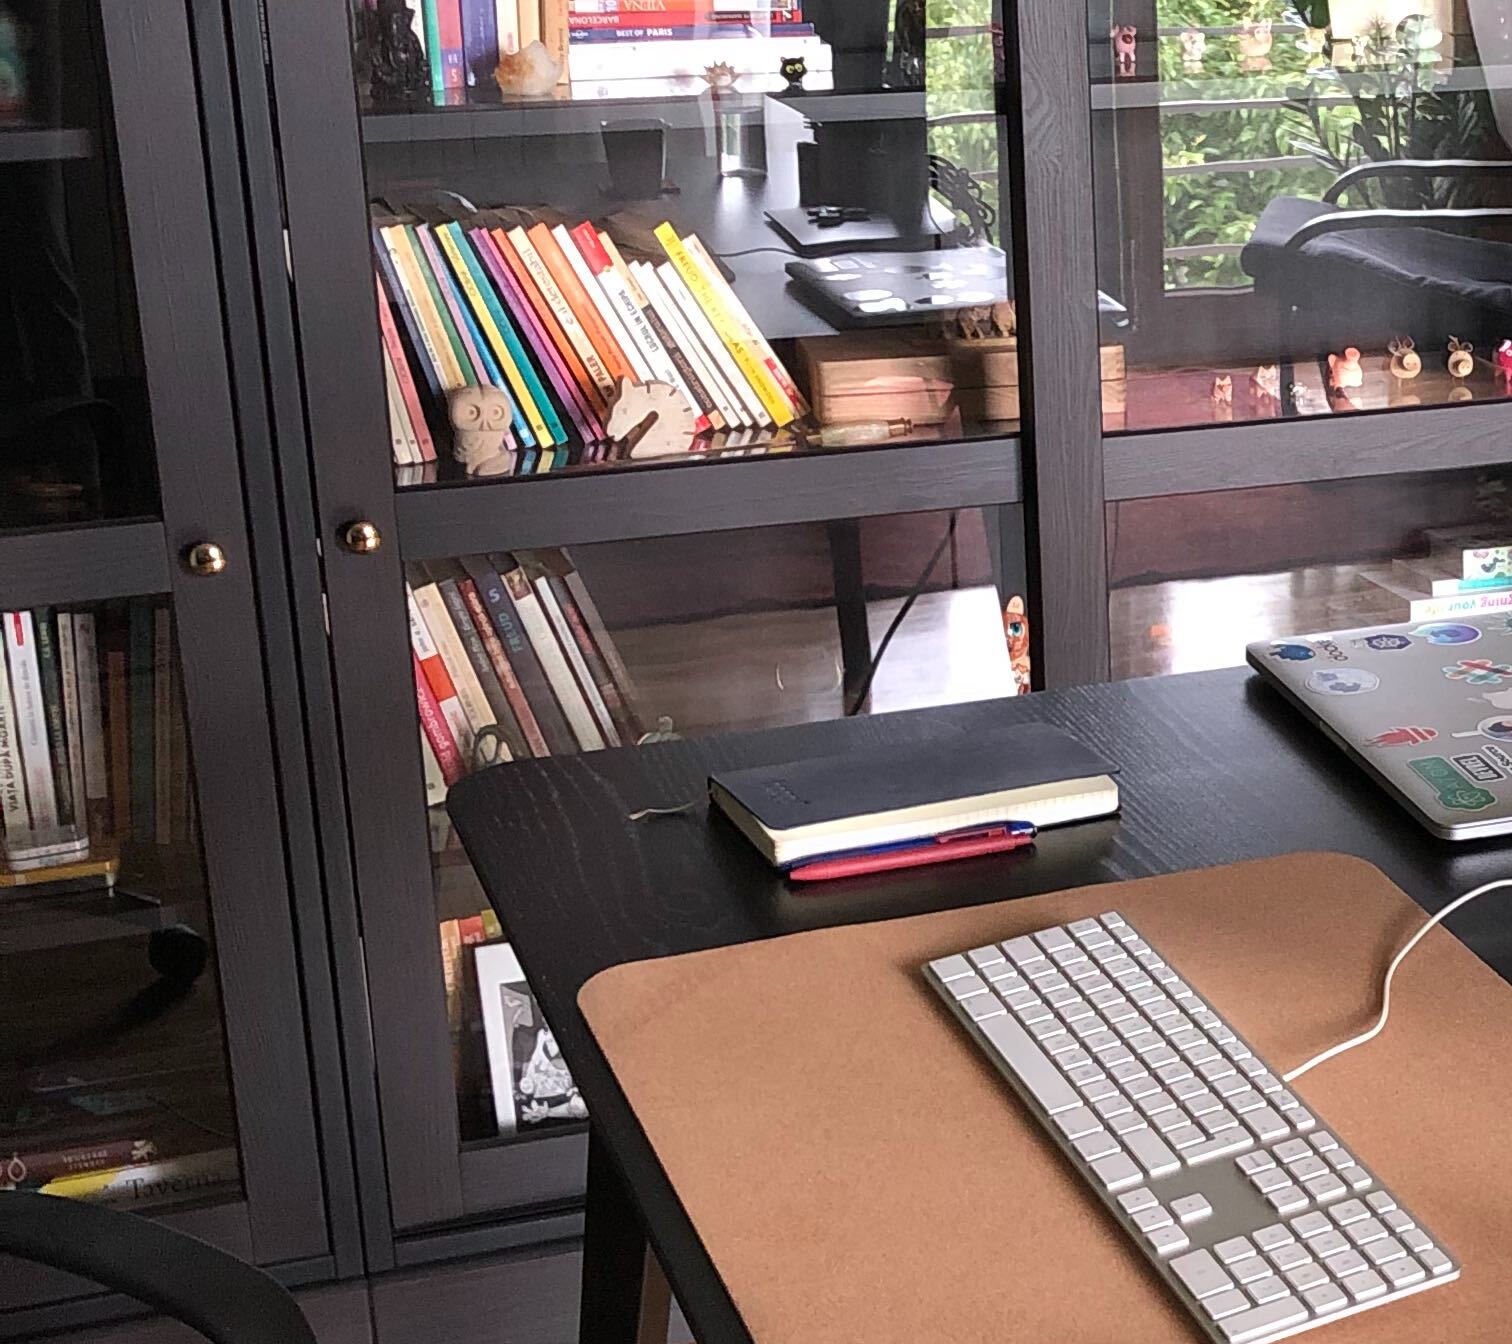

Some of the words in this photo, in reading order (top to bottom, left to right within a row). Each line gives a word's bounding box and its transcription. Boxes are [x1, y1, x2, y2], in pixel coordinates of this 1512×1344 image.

[623, 0, 667, 12] VIENA
[646, 27, 673, 37] PARIS
[1448, 600, 1479, 612] your
[495, 610, 525, 655] FREUD
